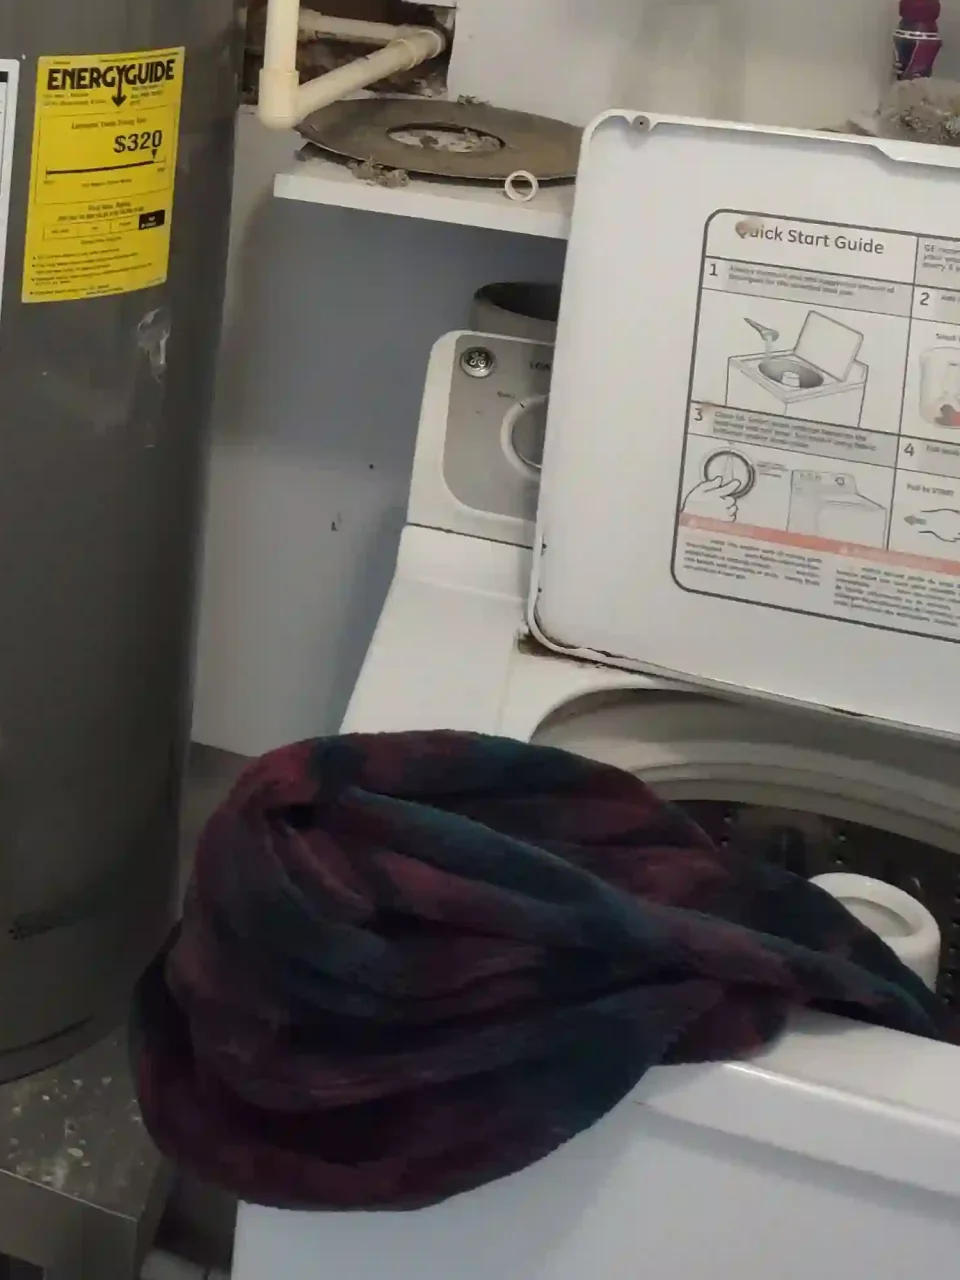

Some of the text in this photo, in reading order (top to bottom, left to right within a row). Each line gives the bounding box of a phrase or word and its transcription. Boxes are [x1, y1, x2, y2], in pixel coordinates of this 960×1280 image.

[113, 129, 163, 153] $320
[735, 220, 885, 254] Quick Start Guide
[708, 263, 718, 277] 1
[920, 292, 930, 306] 2
[693, 407, 703, 421] 3
[904, 443, 914, 457] 4
